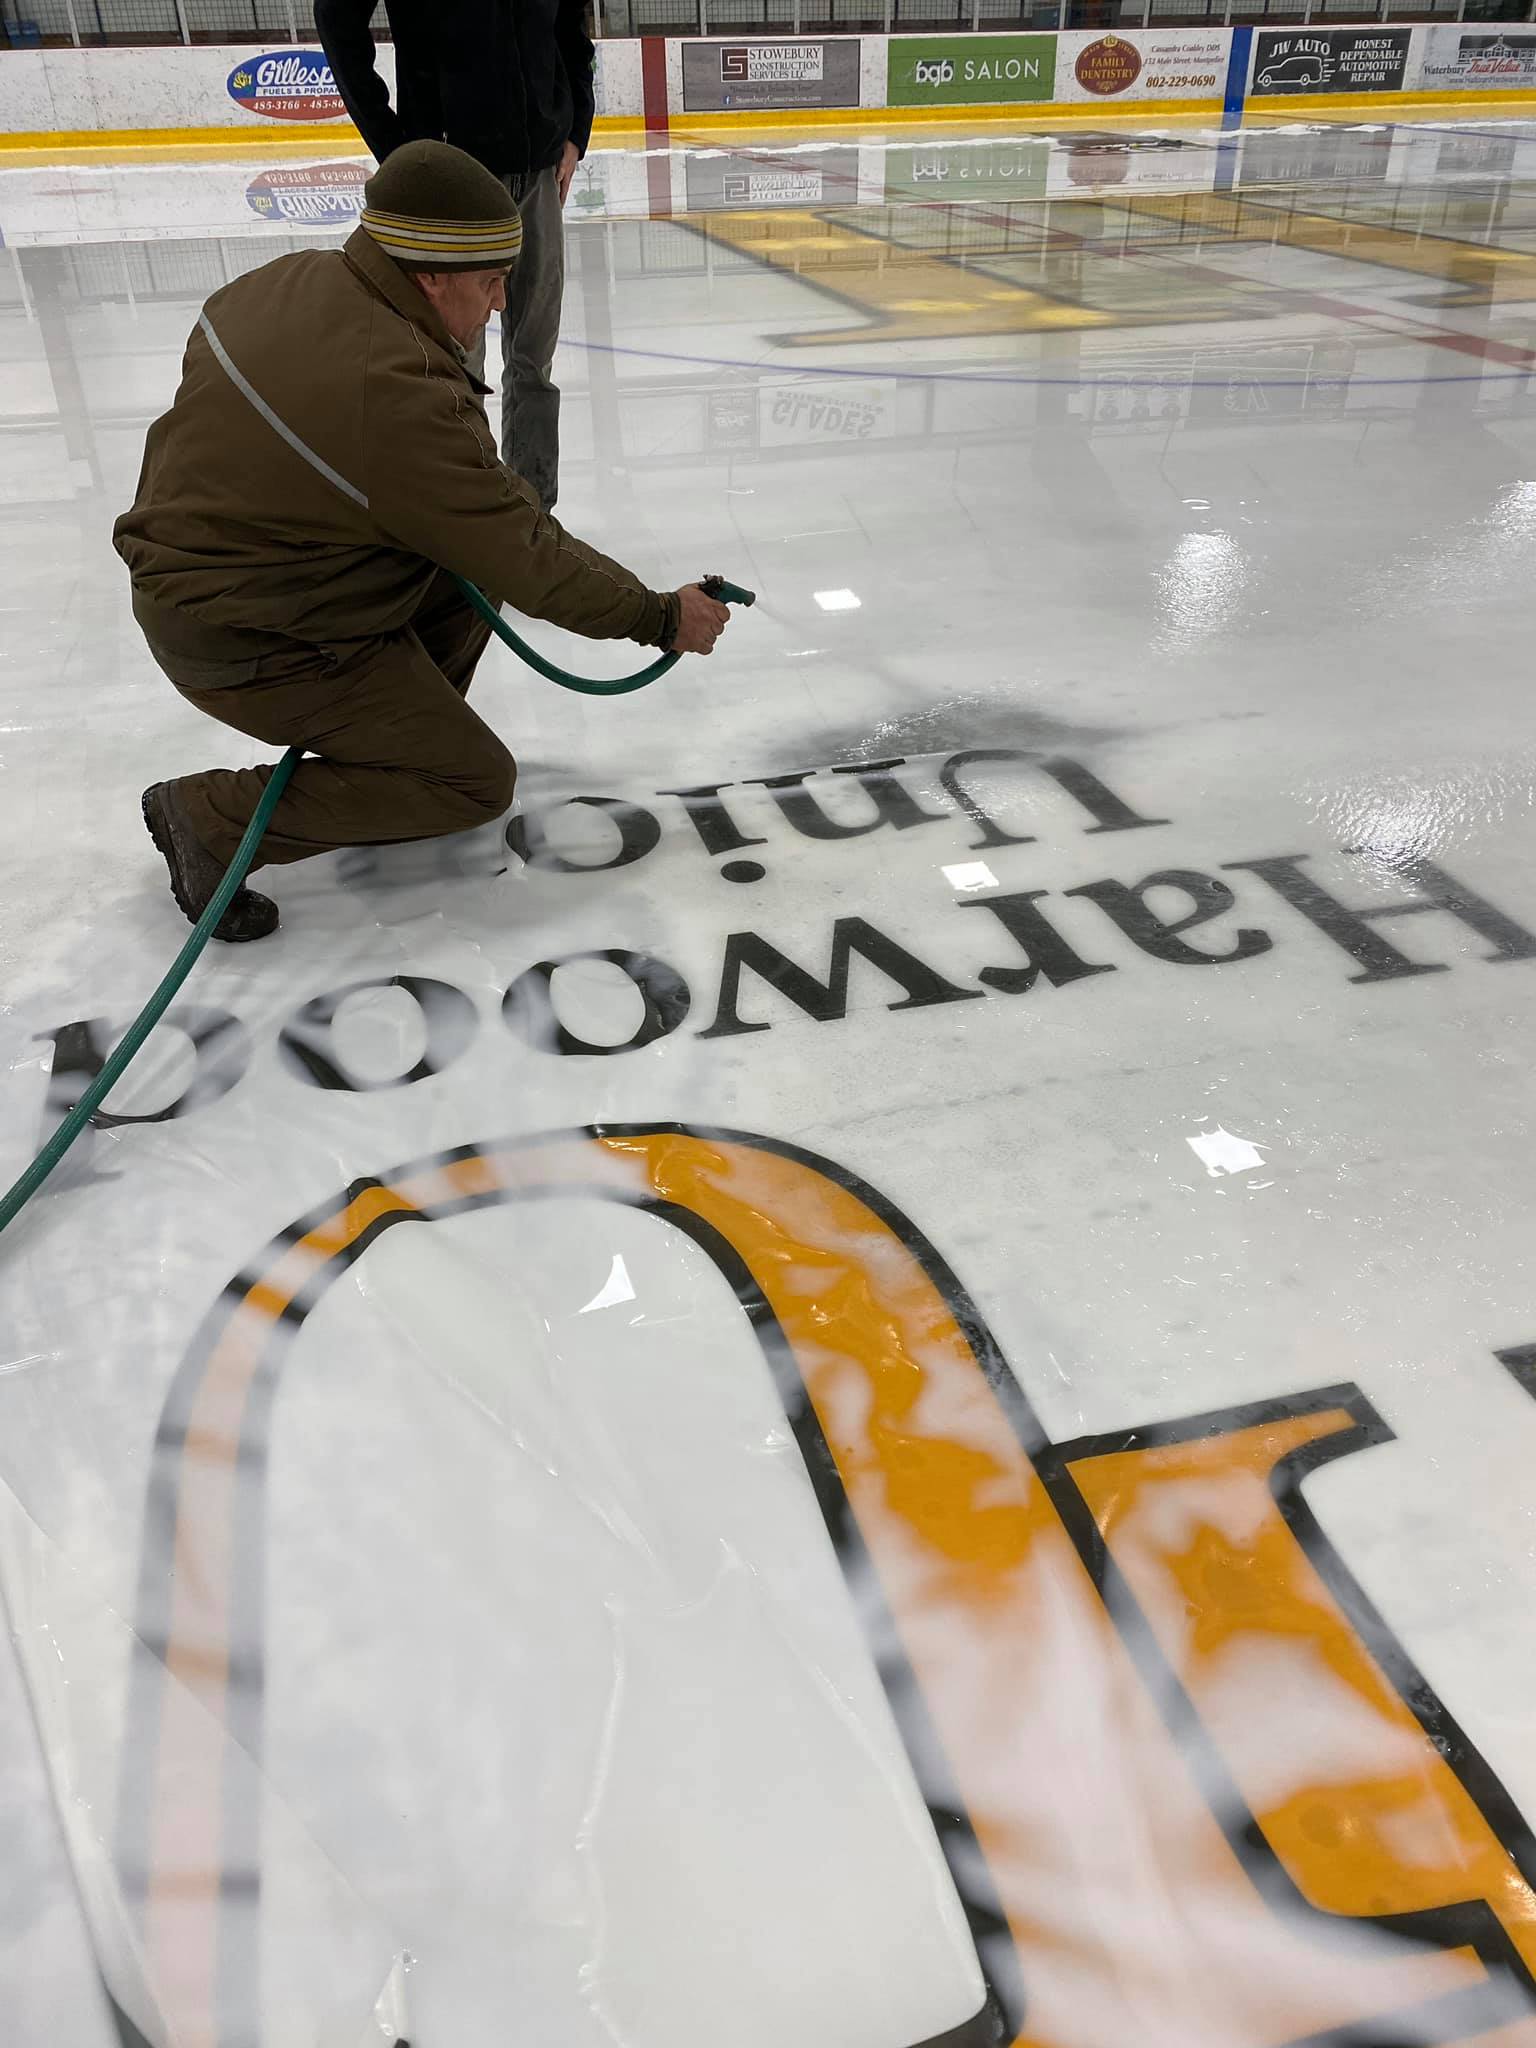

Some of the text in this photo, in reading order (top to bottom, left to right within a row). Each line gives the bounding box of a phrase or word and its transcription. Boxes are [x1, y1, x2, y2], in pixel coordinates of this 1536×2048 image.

[1269, 38, 1331, 58] JW AUTO
[1354, 38, 1394, 49] HONEST
[749, 47, 821, 60] STOWEBURY
[1339, 50, 1404, 61] DEPENDABLE
[749, 60, 820, 71] CONSTRUCTION
[1091, 57, 1127, 67] FAMILY
[1157, 57, 1172, 65] Main
[1338, 61, 1402, 72] AUTOMOTIVE
[256, 57, 336, 88] Gillesp
[749, 70, 807, 80] SERVICES LLC
[964, 59, 1040, 80] SALON
[1080, 68, 1135, 80] DENTISTRY
[1424, 64, 1466, 76] Waterbury
[1145, 75, 1216, 88] 802-229-0690
[1350, 71, 1386, 83] REPAIR
[263, 88, 292, 96] FUELS
[304, 87, 340, 96] PROPA
[309, 99, 345, 110] 485-80
[32, 853, 1536, 1178] Harwood
